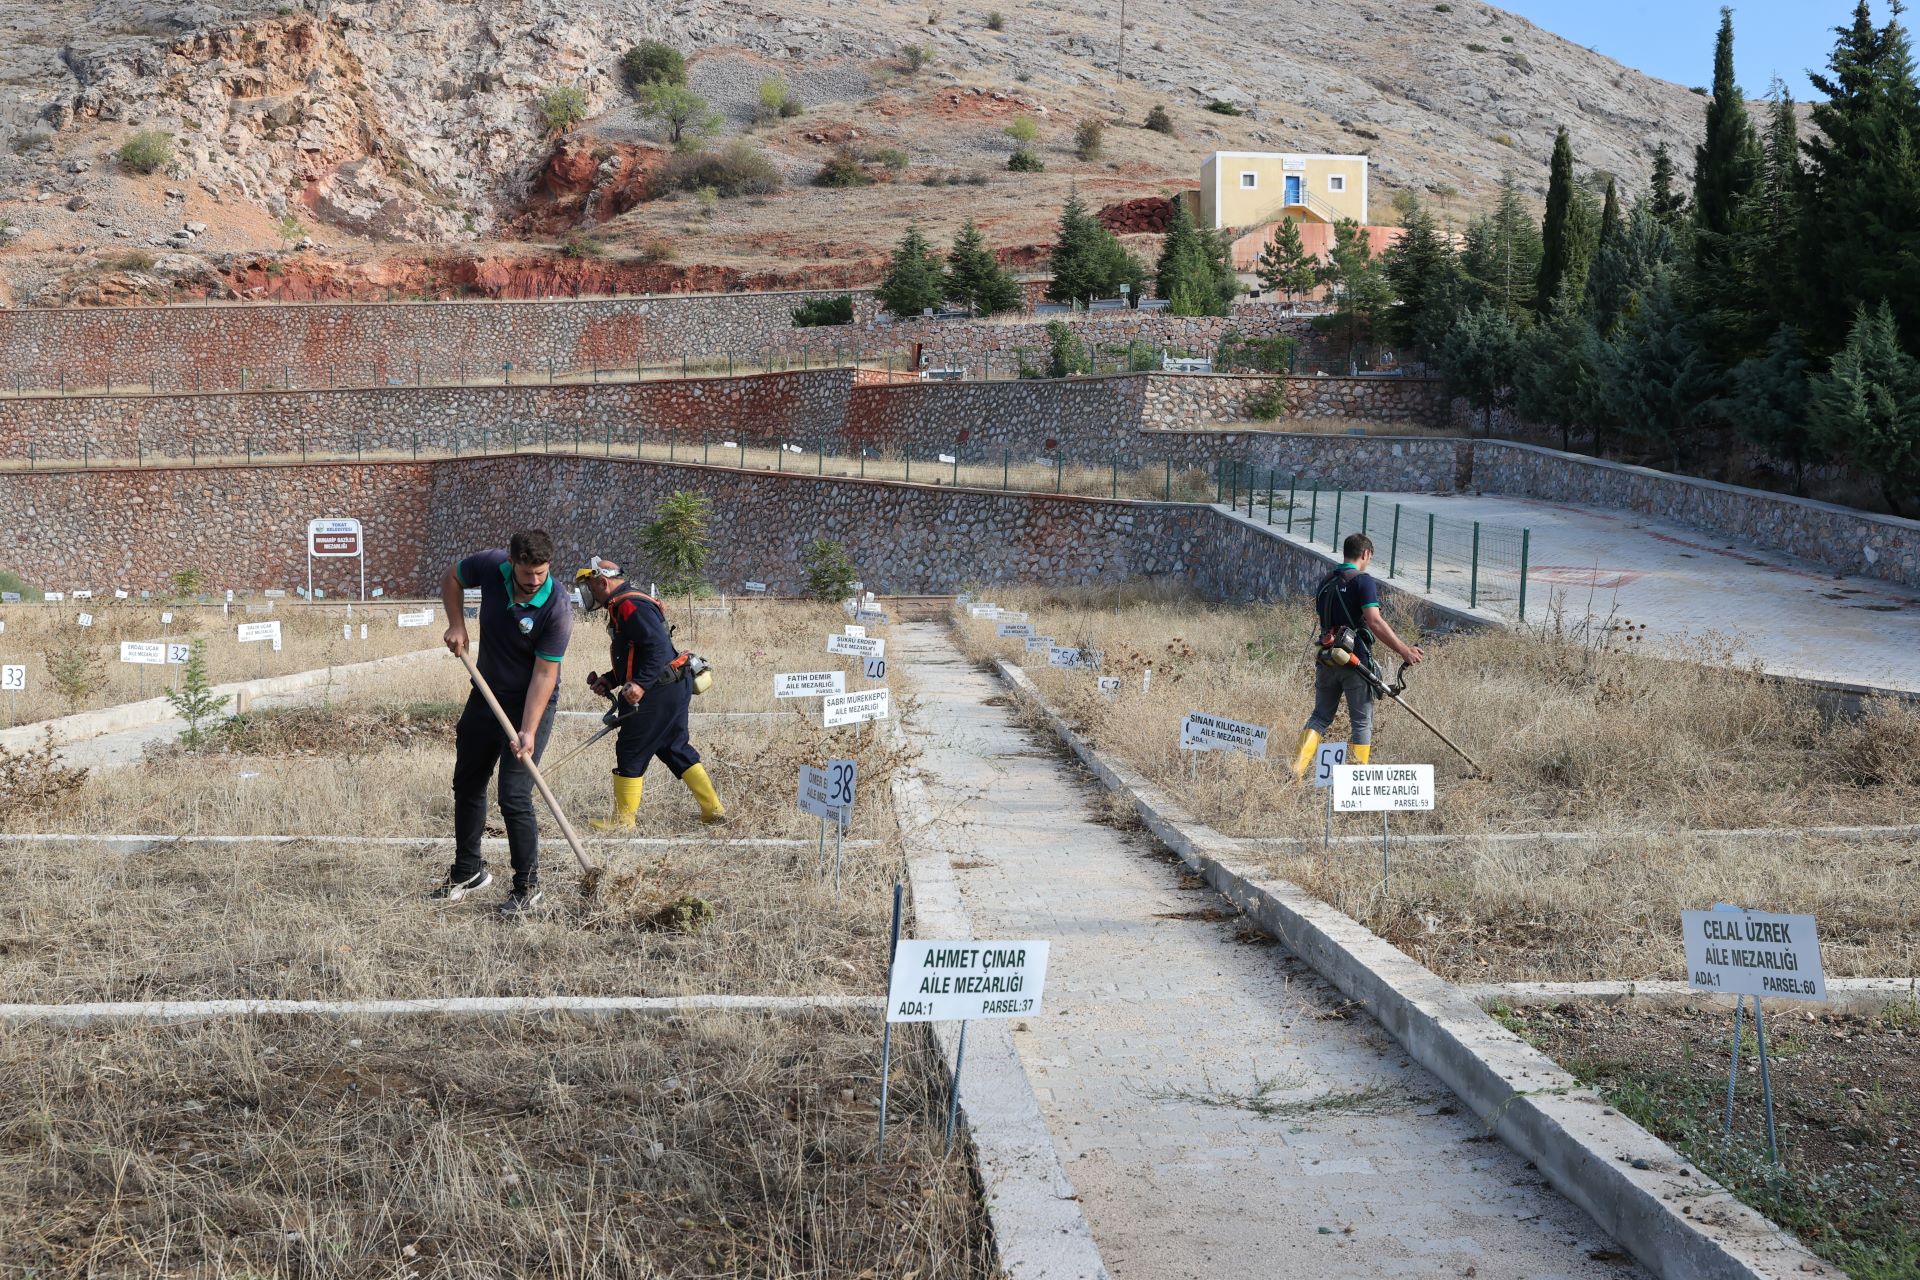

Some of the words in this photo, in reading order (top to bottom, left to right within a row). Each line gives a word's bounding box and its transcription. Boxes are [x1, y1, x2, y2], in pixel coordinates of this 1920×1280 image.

[170, 646, 187, 662] 32
[1061, 651, 1075, 666] 56
[5, 668, 24, 687] 33
[787, 674, 808, 682] FATİH
[809, 673, 832, 681] DEMİR
[801, 681, 835, 689] MEZARLIĞI
[835, 707, 848, 715] AİLE
[848, 702, 879, 713] MEZARLIĞI
[1190, 713, 1215, 727] SİNAN
[1216, 720, 1267, 739] KILIÇARSLAN
[1200, 726, 1215, 738] AİLE
[1320, 749, 1344, 779] 59
[1352, 768, 1384, 781] SEVİM
[1386, 767, 1417, 781] ÜZREK
[831, 764, 853, 803] 38
[1351, 783, 1372, 796] AİLE
[1373, 782, 1420, 796] MEZARLIĞI
[1703, 919, 1743, 941] CELAL
[1745, 916, 1792, 944] ÜZREK
[923, 949, 979, 968] AHMET
[982, 949, 1026, 973] ÇINAR
[1705, 943, 1729, 966] AİLE
[1731, 947, 1798, 971] MEZARLIĞI
[919, 972, 951, 993] AİLE
[953, 972, 1023, 994] MEZARLIĞI
[1695, 971, 1721, 987] ADA:1
[1763, 976, 1816, 995] PARSEL:60
[898, 1002, 934, 1016] ADA:1
[982, 999, 1034, 1014] PARSEL:37
